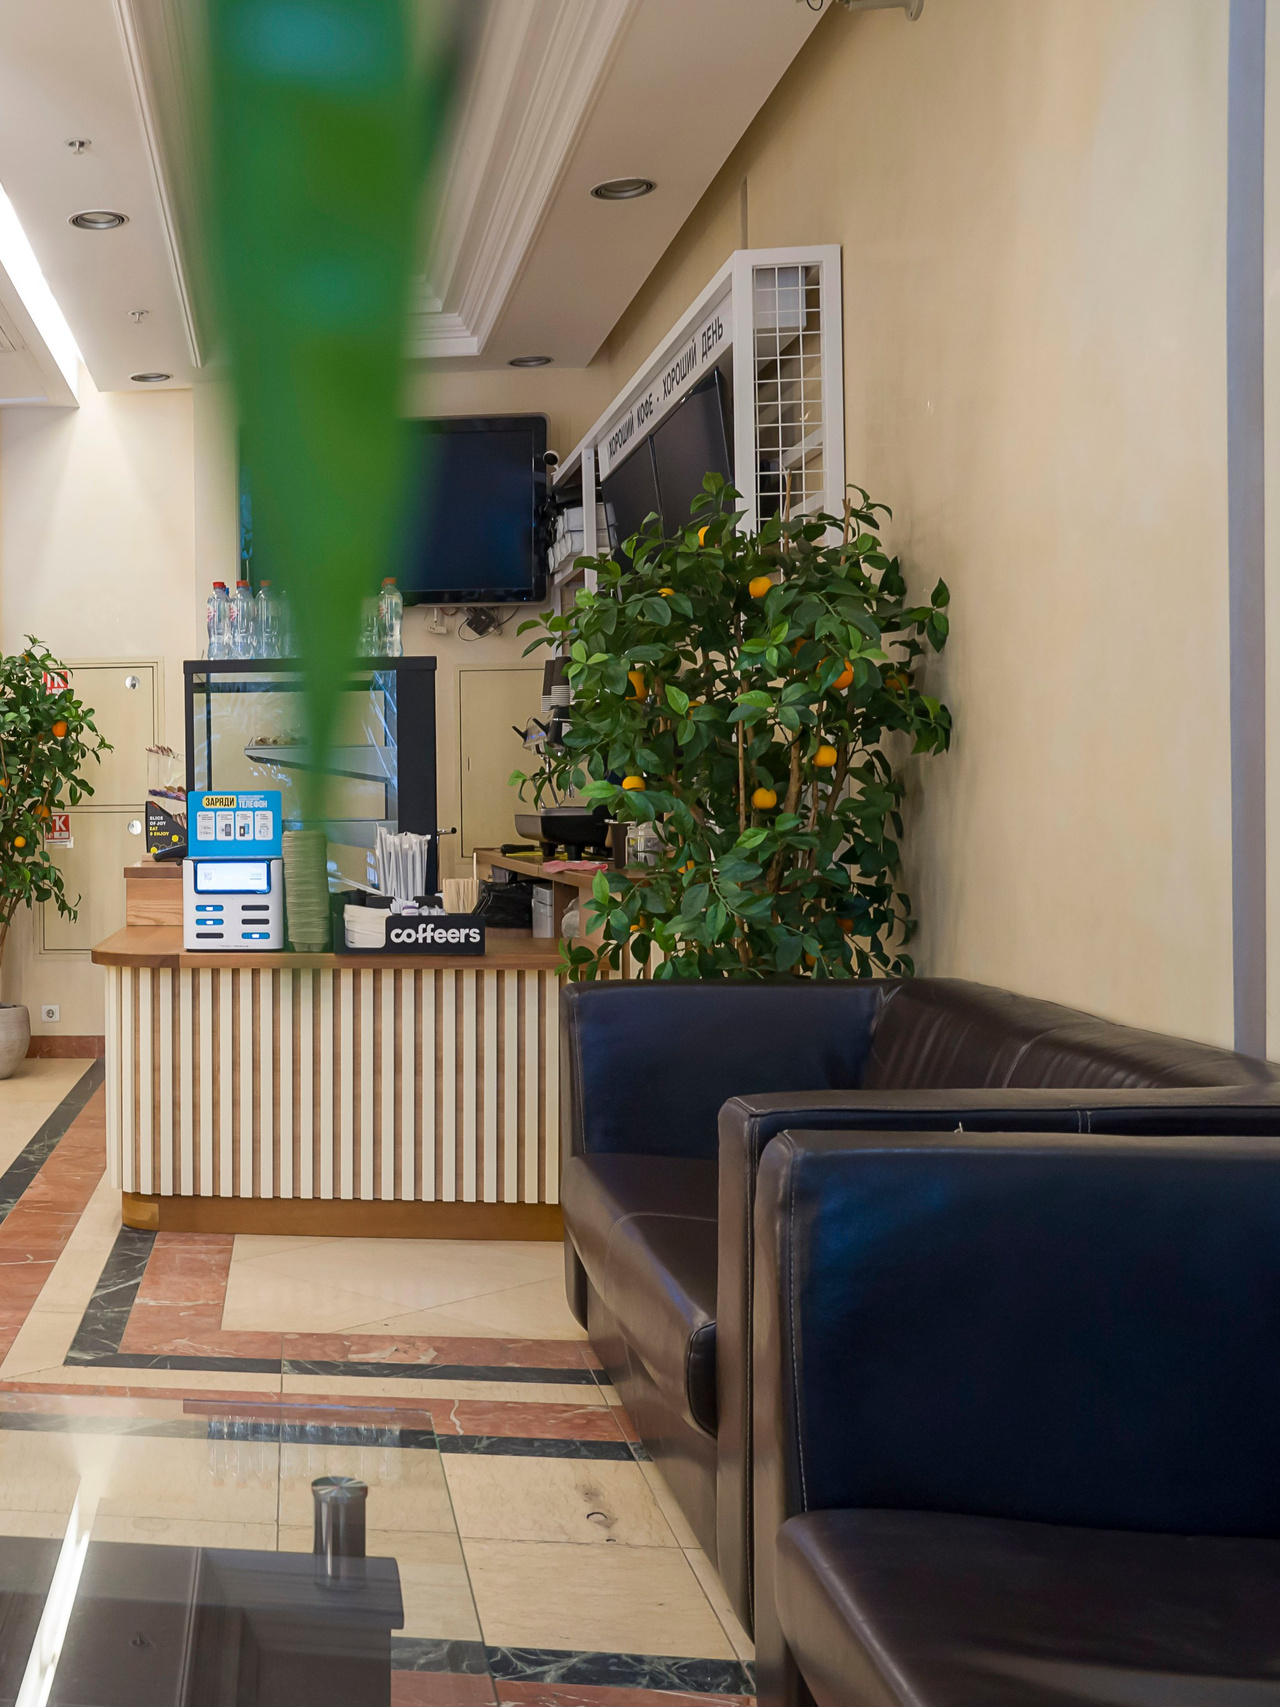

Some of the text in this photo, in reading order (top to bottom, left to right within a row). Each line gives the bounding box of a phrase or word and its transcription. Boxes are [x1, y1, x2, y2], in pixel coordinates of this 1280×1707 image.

[608, 410, 635, 460] ХОРОШИЙ
[637, 392, 654, 428] КОФЕ
[662, 337, 697, 400] ХОРОШИЙ
[701, 316, 724, 364] ДЕНЬ
[205, 797, 235, 808] ЗАРЯДИ
[238, 800, 268, 808] ТЕЛЕФОН
[390, 923, 481, 943] coffeers
